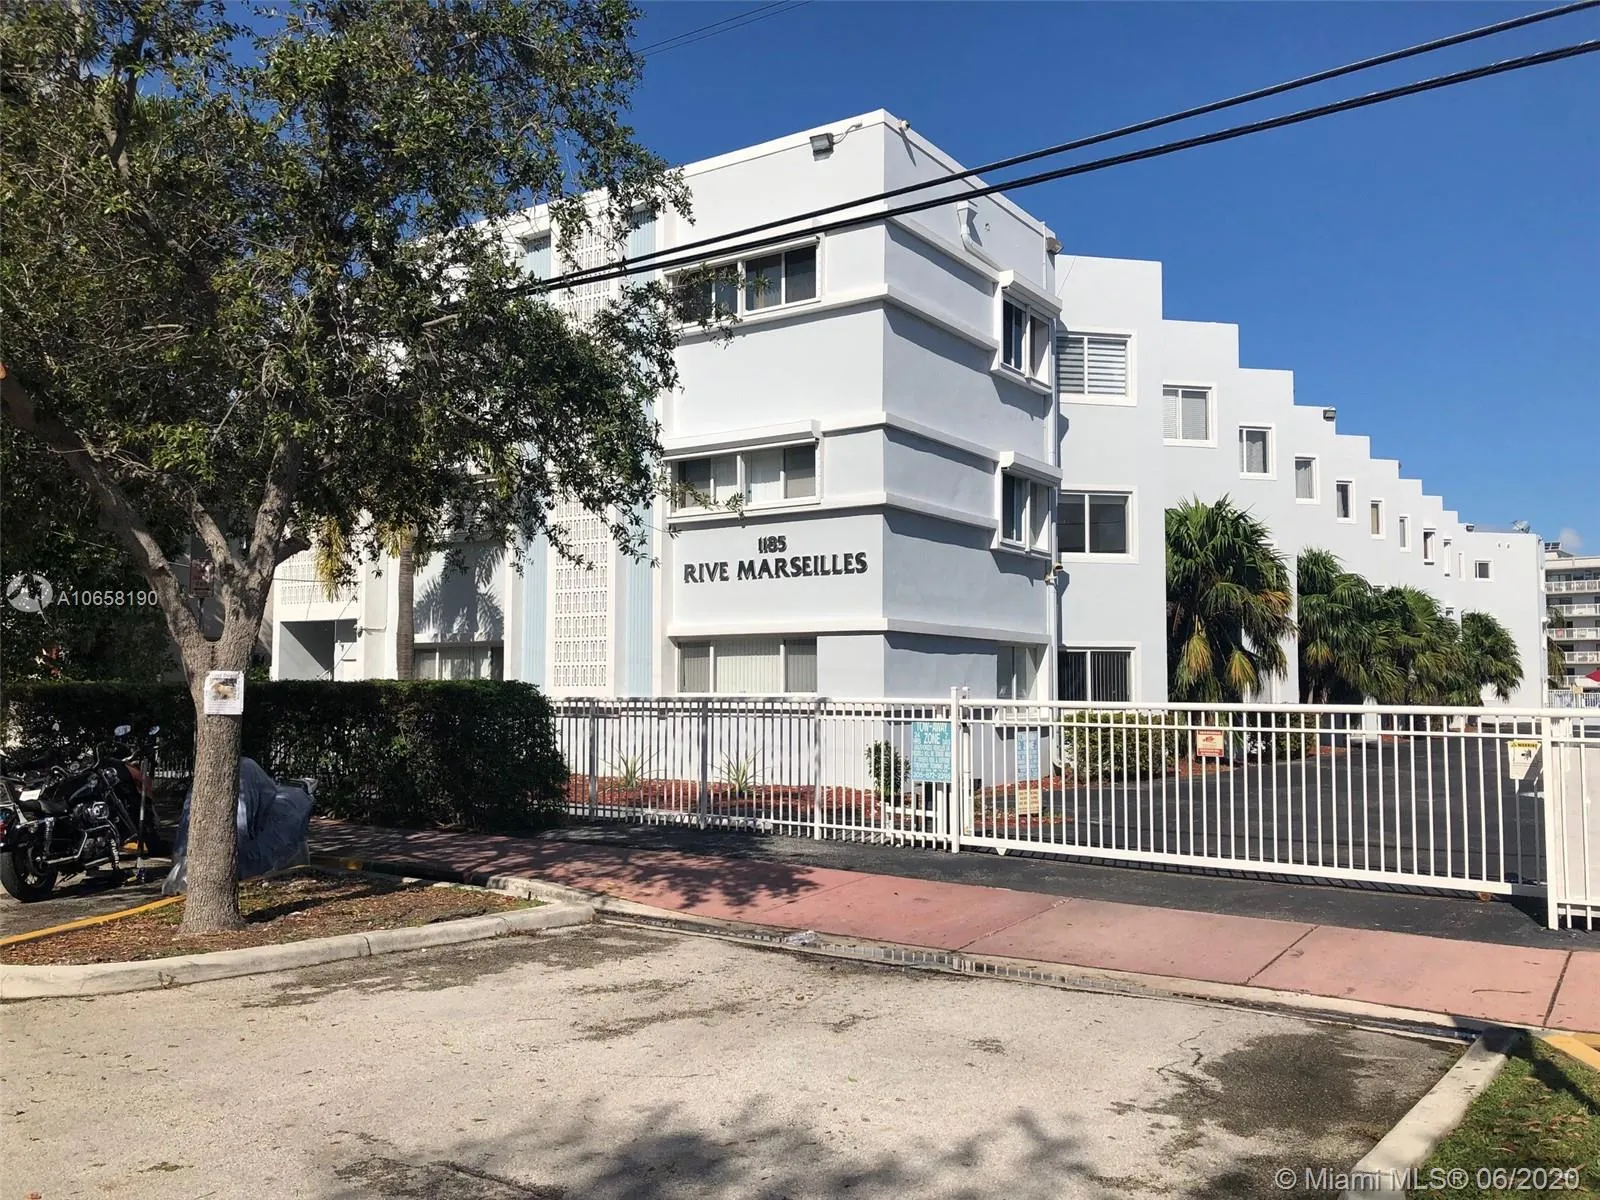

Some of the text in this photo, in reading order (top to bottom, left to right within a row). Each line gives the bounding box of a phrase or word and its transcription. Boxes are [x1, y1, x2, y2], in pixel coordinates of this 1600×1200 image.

[758, 535, 787, 553] 1185
[683, 552, 868, 583] RIVE MARSEILLES
[923, 732, 941, 744] ZONE
